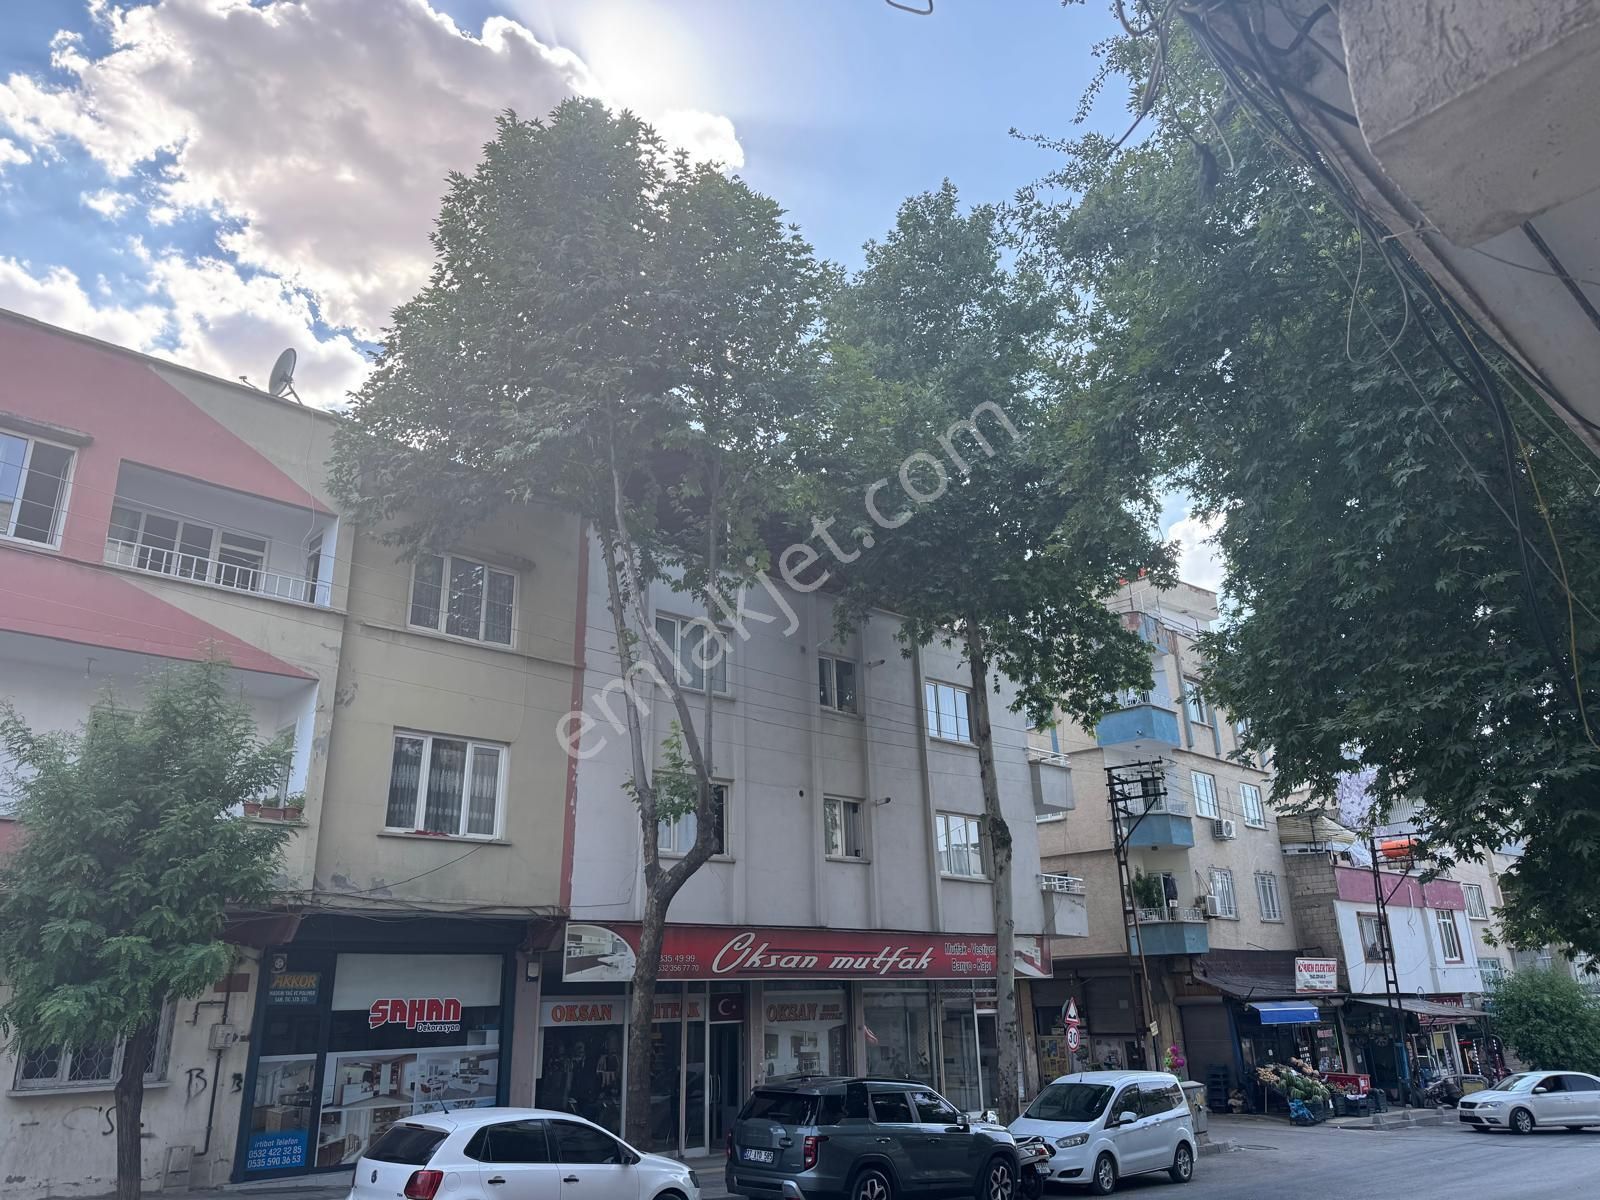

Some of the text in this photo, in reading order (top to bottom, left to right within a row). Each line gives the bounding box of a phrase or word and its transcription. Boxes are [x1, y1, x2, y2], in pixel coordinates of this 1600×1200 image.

[712, 932, 934, 974] Oksan mutfak
[945, 943, 967, 955] Mutfak
[952, 958, 972, 973] Banyo
[272, 975, 317, 988] AKKOR
[551, 1004, 612, 1023] OKSAN
[767, 1003, 817, 1022] OKSAN
[417, 1022, 460, 1033] Dekorasyon
[1068, 1031, 1077, 1044] 30
[276, 1138, 299, 1146] Telefon
[249, 1145, 302, 1159] 0532 422 32 85
[248, 1154, 301, 1169] 0535 590 36 53
